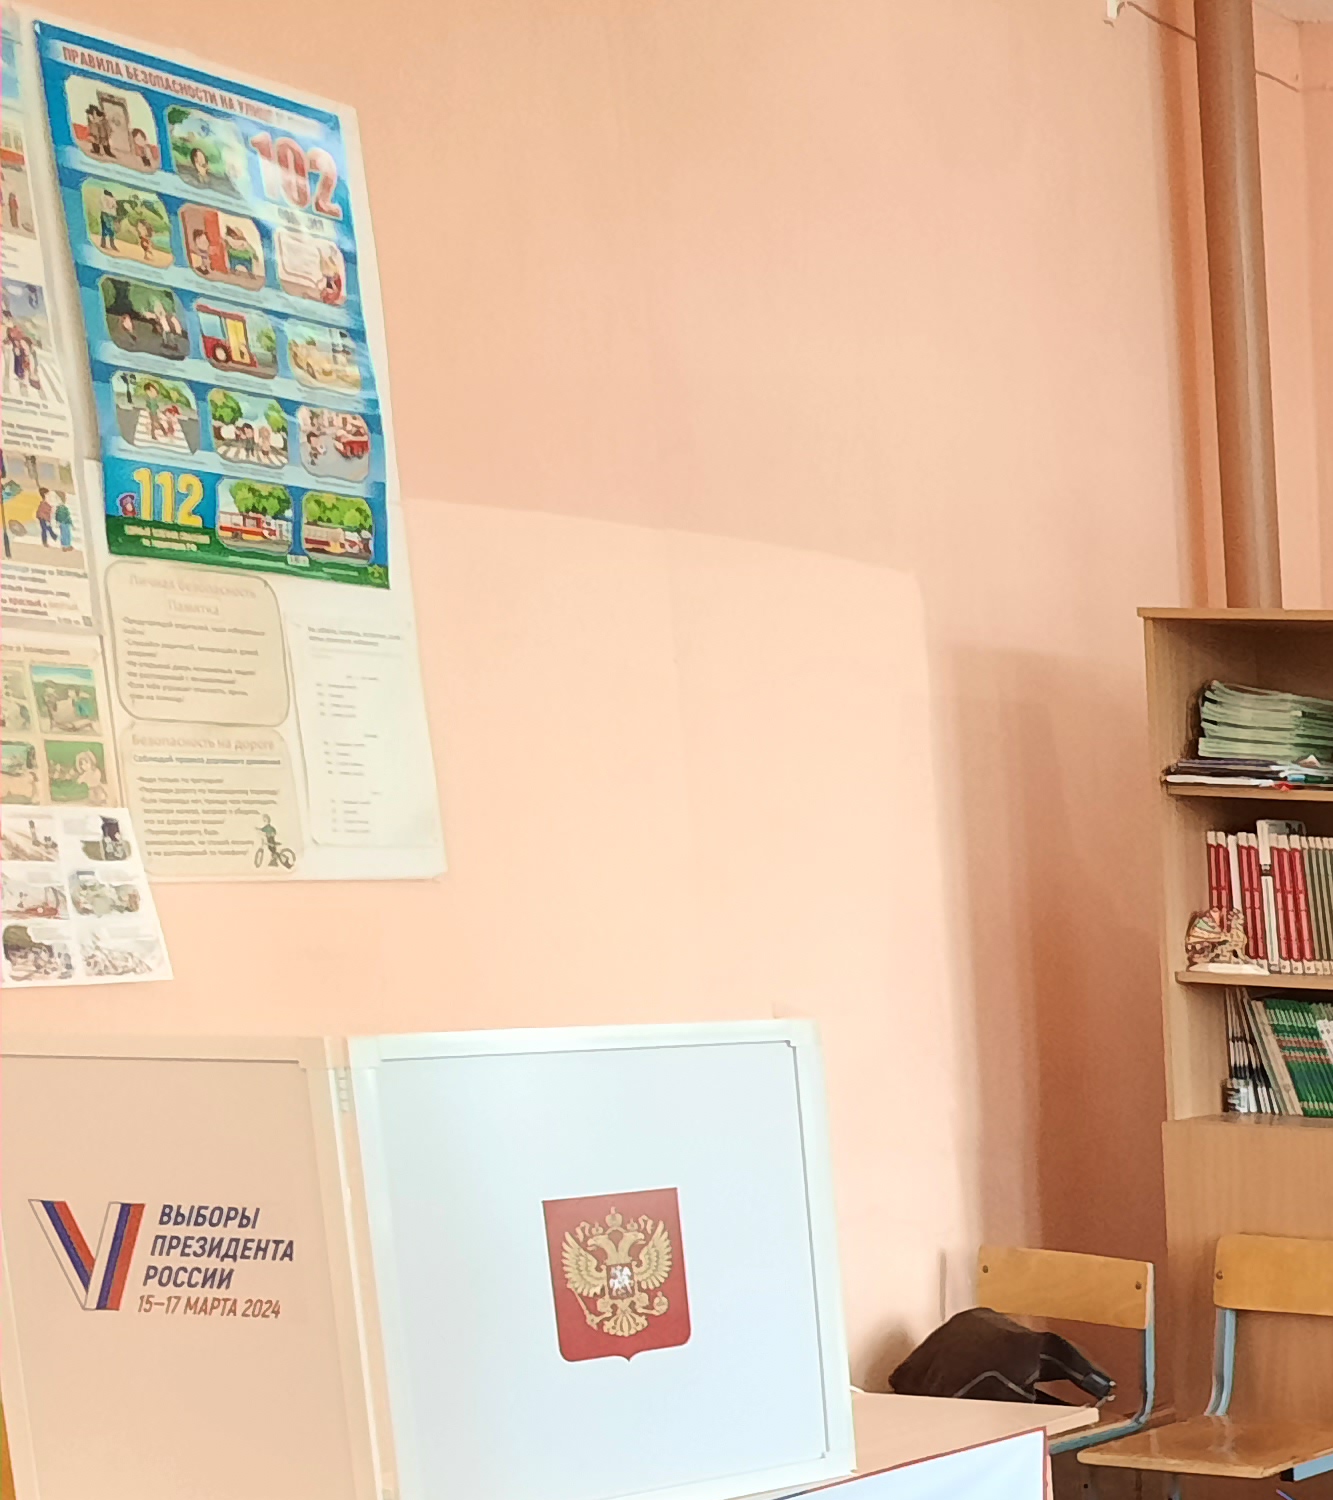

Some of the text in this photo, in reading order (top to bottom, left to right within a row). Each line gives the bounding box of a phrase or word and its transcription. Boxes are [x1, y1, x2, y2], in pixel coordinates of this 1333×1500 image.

[63, 46, 123, 77] ПРАВИЛА
[126, 66, 217, 102] БЕЗОПАСНОСТИ
[220, 91, 235, 110] НА
[251, 132, 342, 220] 102
[134, 468, 203, 528] 112
[159, 1204, 260, 1229] ВЫБОРЫ
[150, 1235, 294, 1261] ПРЕЗИДЕНТА
[143, 1266, 234, 1290] РОССИИ
[184, 1297, 237, 1316] МАРТА
[242, 1298, 281, 1318] 2024
